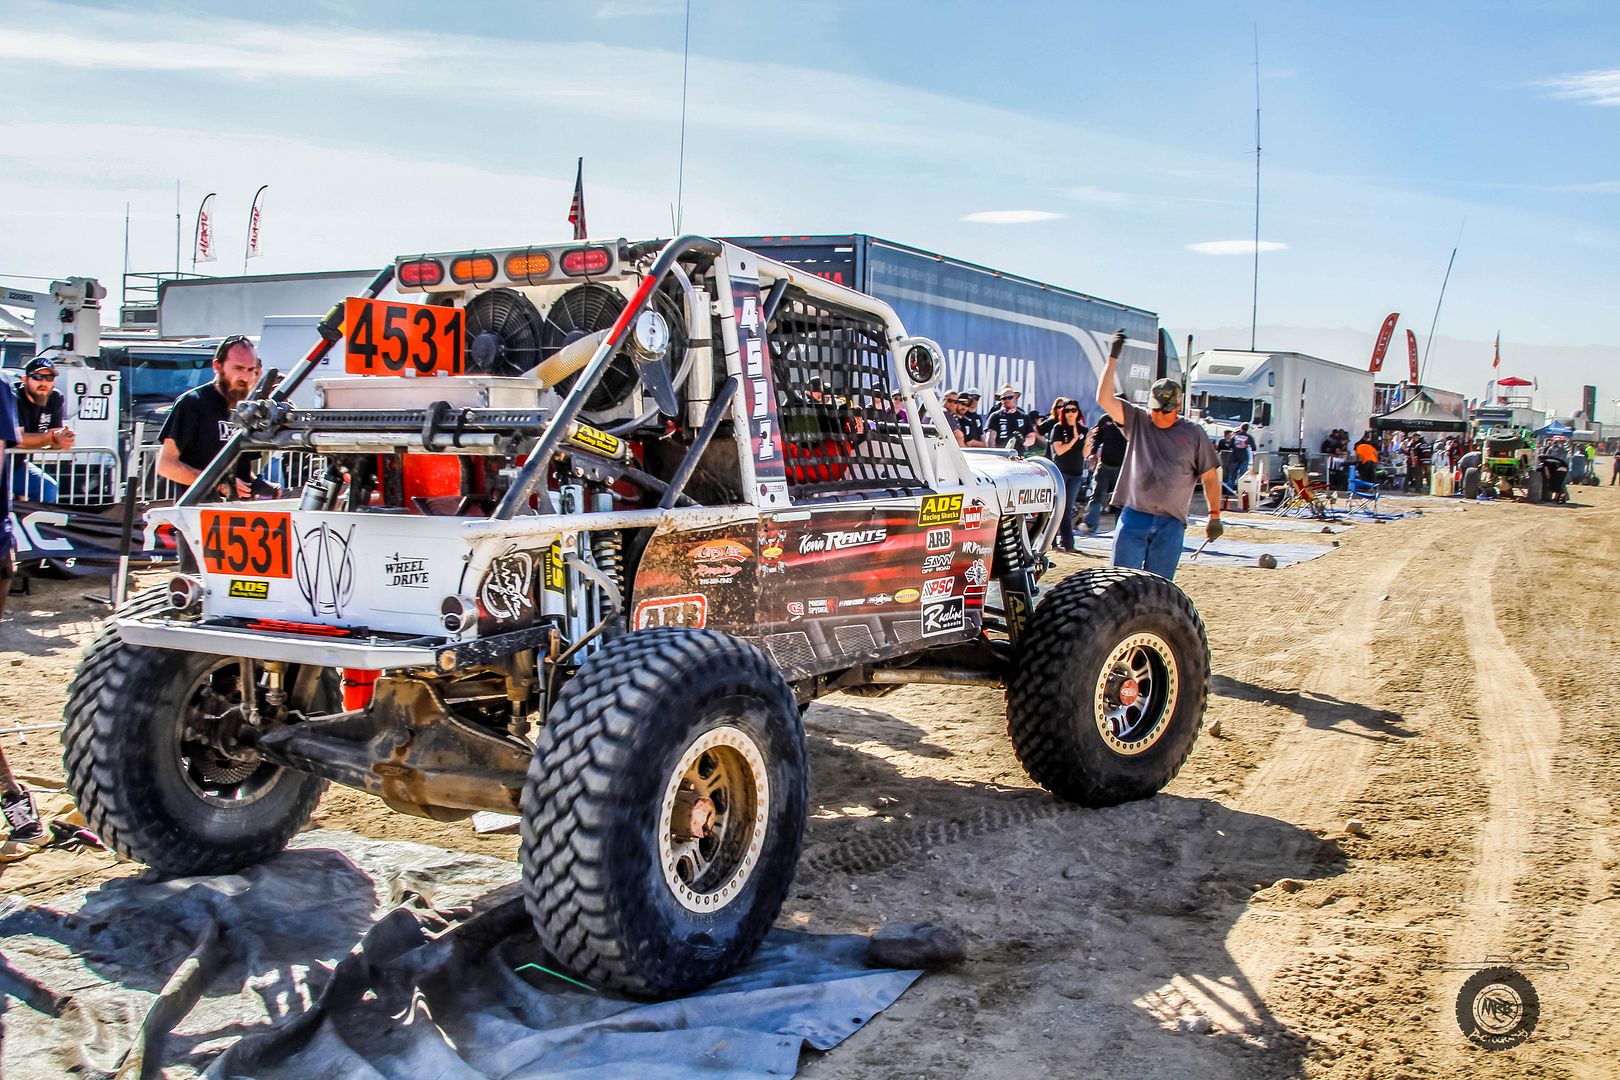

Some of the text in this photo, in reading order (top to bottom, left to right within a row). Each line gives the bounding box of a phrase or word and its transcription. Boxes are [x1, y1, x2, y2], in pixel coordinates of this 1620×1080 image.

[347, 302, 461, 374] 4531
[948, 349, 1035, 416] YAMAHA
[922, 496, 962, 513] ADS
[1018, 488, 1052, 504] FALKEN
[922, 513, 941, 521] Racing
[203, 514, 289, 574] 4531
[799, 532, 825, 554] Kevin
[822, 528, 887, 551] RANTS
[927, 530, 951, 548] ARB
[393, 552, 399, 562] 4
[385, 560, 424, 574] WHEEL
[231, 581, 268, 592] ADS
[393, 572, 429, 586] DRIVE
[929, 578, 954, 596] PSC
[646, 602, 699, 628] ARB
